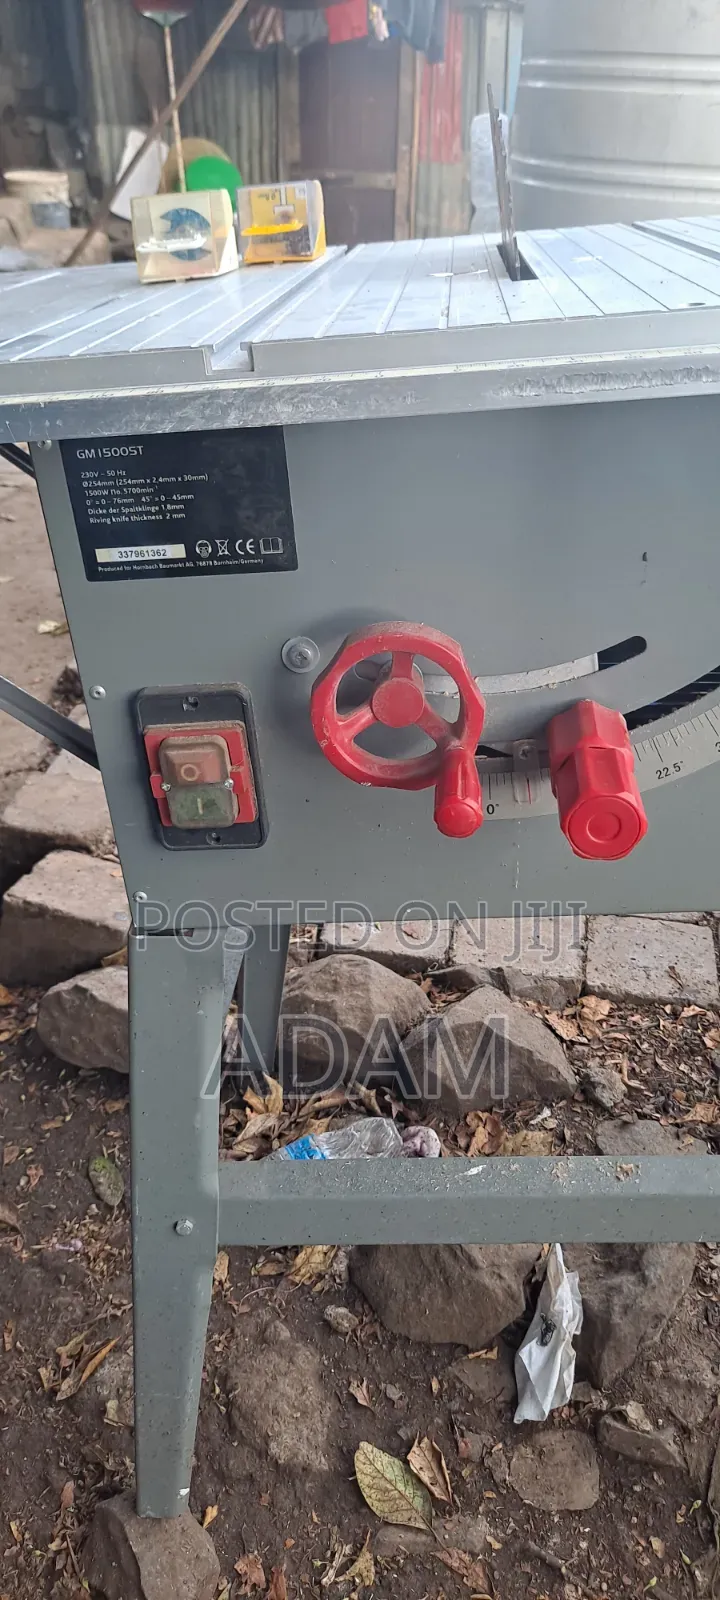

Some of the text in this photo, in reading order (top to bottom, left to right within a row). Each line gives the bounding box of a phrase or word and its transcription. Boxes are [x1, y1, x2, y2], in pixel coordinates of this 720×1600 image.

[116, 478, 145, 487] (254mm
[183, 473, 208, 482] 30mm)
[90, 516, 112, 524] Riving
[112, 514, 130, 523] knife
[130, 512, 162, 522] thickness
[118, 548, 167, 559] 337961362
